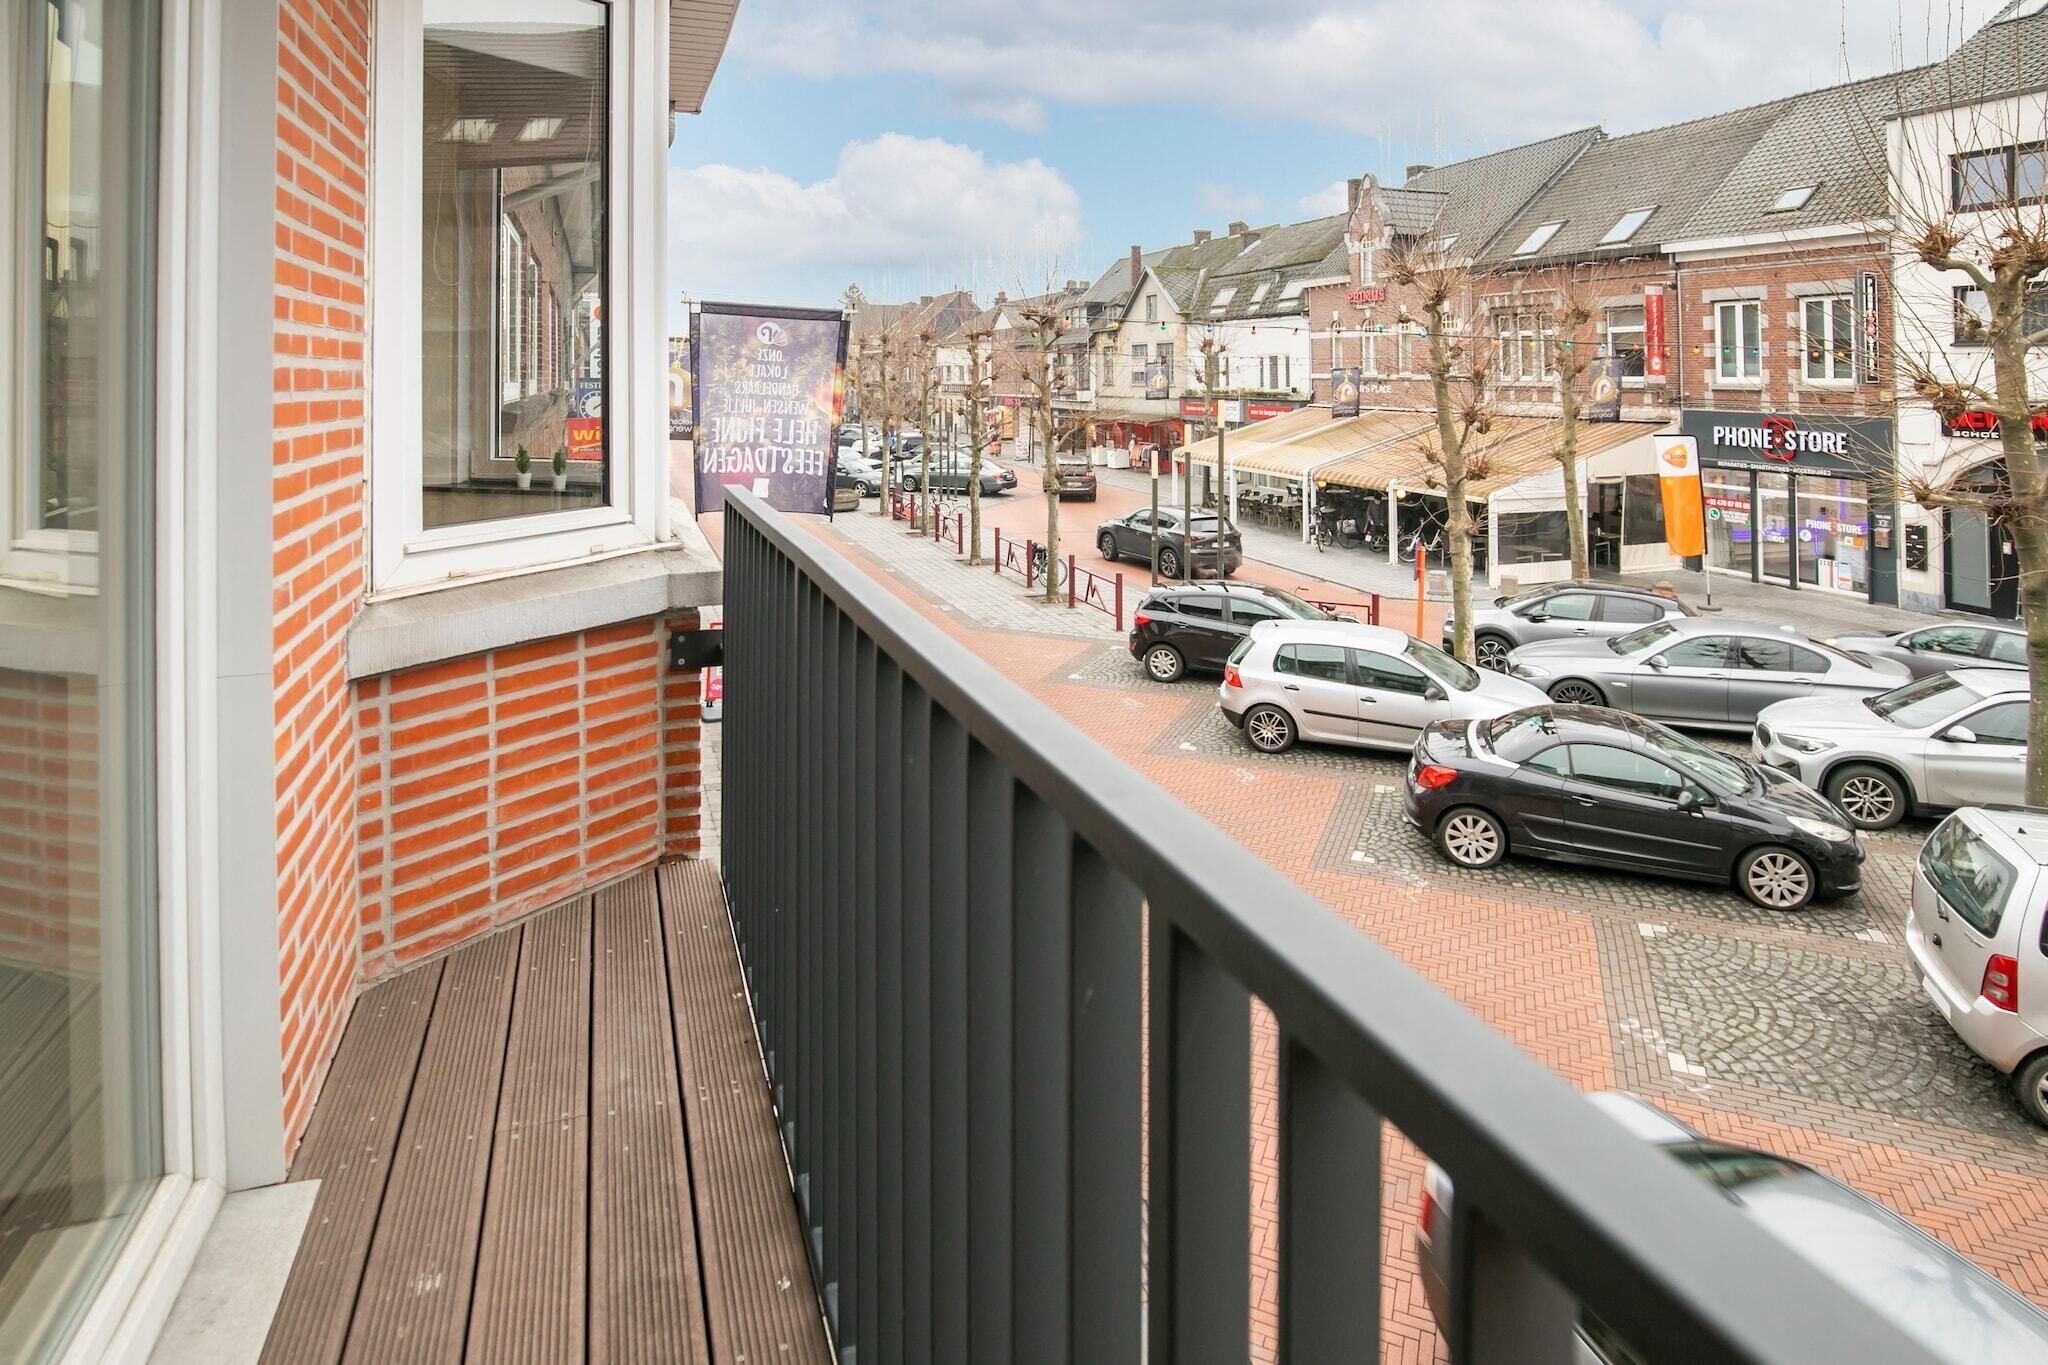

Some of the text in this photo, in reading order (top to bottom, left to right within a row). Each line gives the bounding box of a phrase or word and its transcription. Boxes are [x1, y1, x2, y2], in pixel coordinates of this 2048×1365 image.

[1346, 289, 1385, 303] PRIMUS
[1371, 385, 1392, 393] PLACE
[573, 426, 601, 441] wi
[1713, 426, 1849, 454] PHONE STORE
[1953, 431, 2000, 439] SCHOE
[1806, 519, 1862, 535] PHONE STORE
